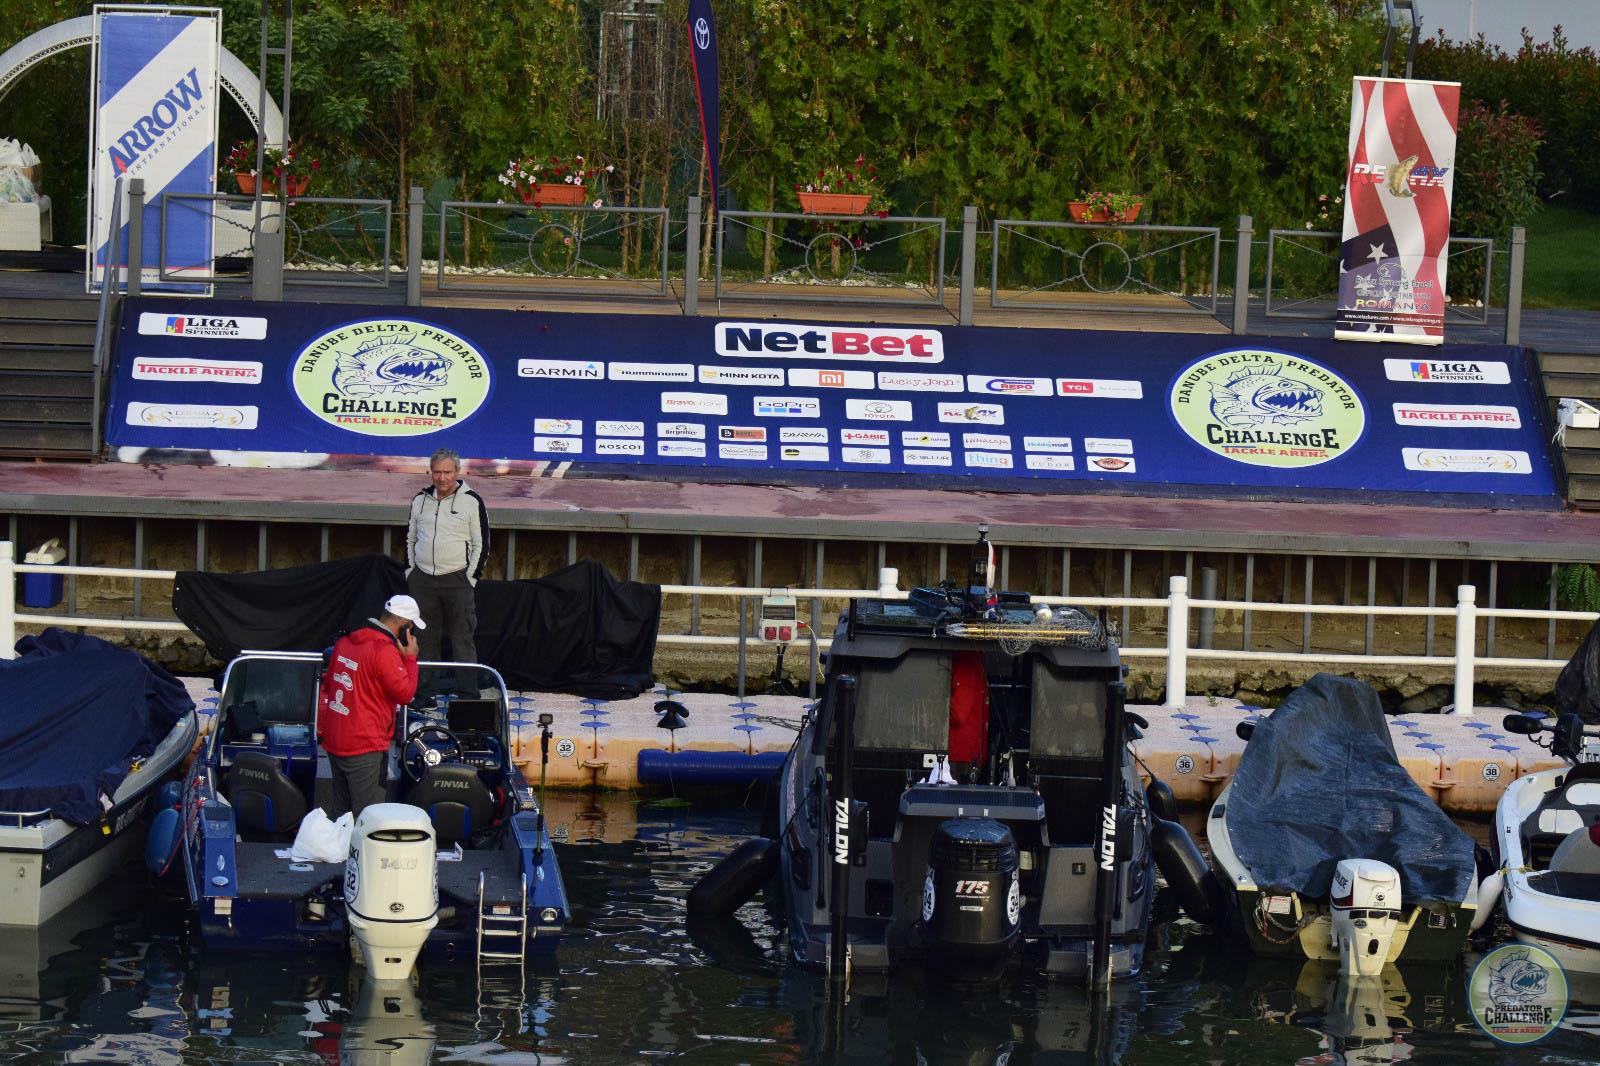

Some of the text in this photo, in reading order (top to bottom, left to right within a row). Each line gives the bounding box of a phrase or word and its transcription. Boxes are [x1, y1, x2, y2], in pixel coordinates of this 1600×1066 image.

[108, 66, 203, 179] ARROW
[131, 104, 206, 175] INTERNATIONAL
[1352, 163, 1450, 187] REAX
[186, 317, 240, 329] LIGA
[185, 328, 239, 336] SPINNING
[725, 327, 934, 358] NetBet
[302, 324, 482, 379] DANUBE DELTA PREDATOR
[137, 364, 258, 377] TACKLE ARENA
[521, 367, 598, 378] GARMIN
[1430, 363, 1482, 373] LIGA
[719, 371, 749, 379] MINN
[1178, 354, 1356, 410] DANUBE DELTA PREDATOR
[322, 392, 457, 419] CHALLENGE
[758, 400, 817, 408] GoPro
[336, 415, 443, 427] TACKLE ARENA
[1398, 410, 1517, 422] TACKLE ARENA
[1206, 423, 1340, 450] CHALLENGE
[1224, 447, 1329, 459] TACKLE ARENA
[560, 744, 571, 752] 32
[1179, 760, 1191, 769] 36
[238, 767, 271, 782] FINVAL
[1485, 768, 1497, 776] 38
[433, 779, 471, 790] FINVAL
[835, 797, 849, 865] TALON
[1100, 803, 1117, 871] TALON
[955, 880, 990, 895] 175
